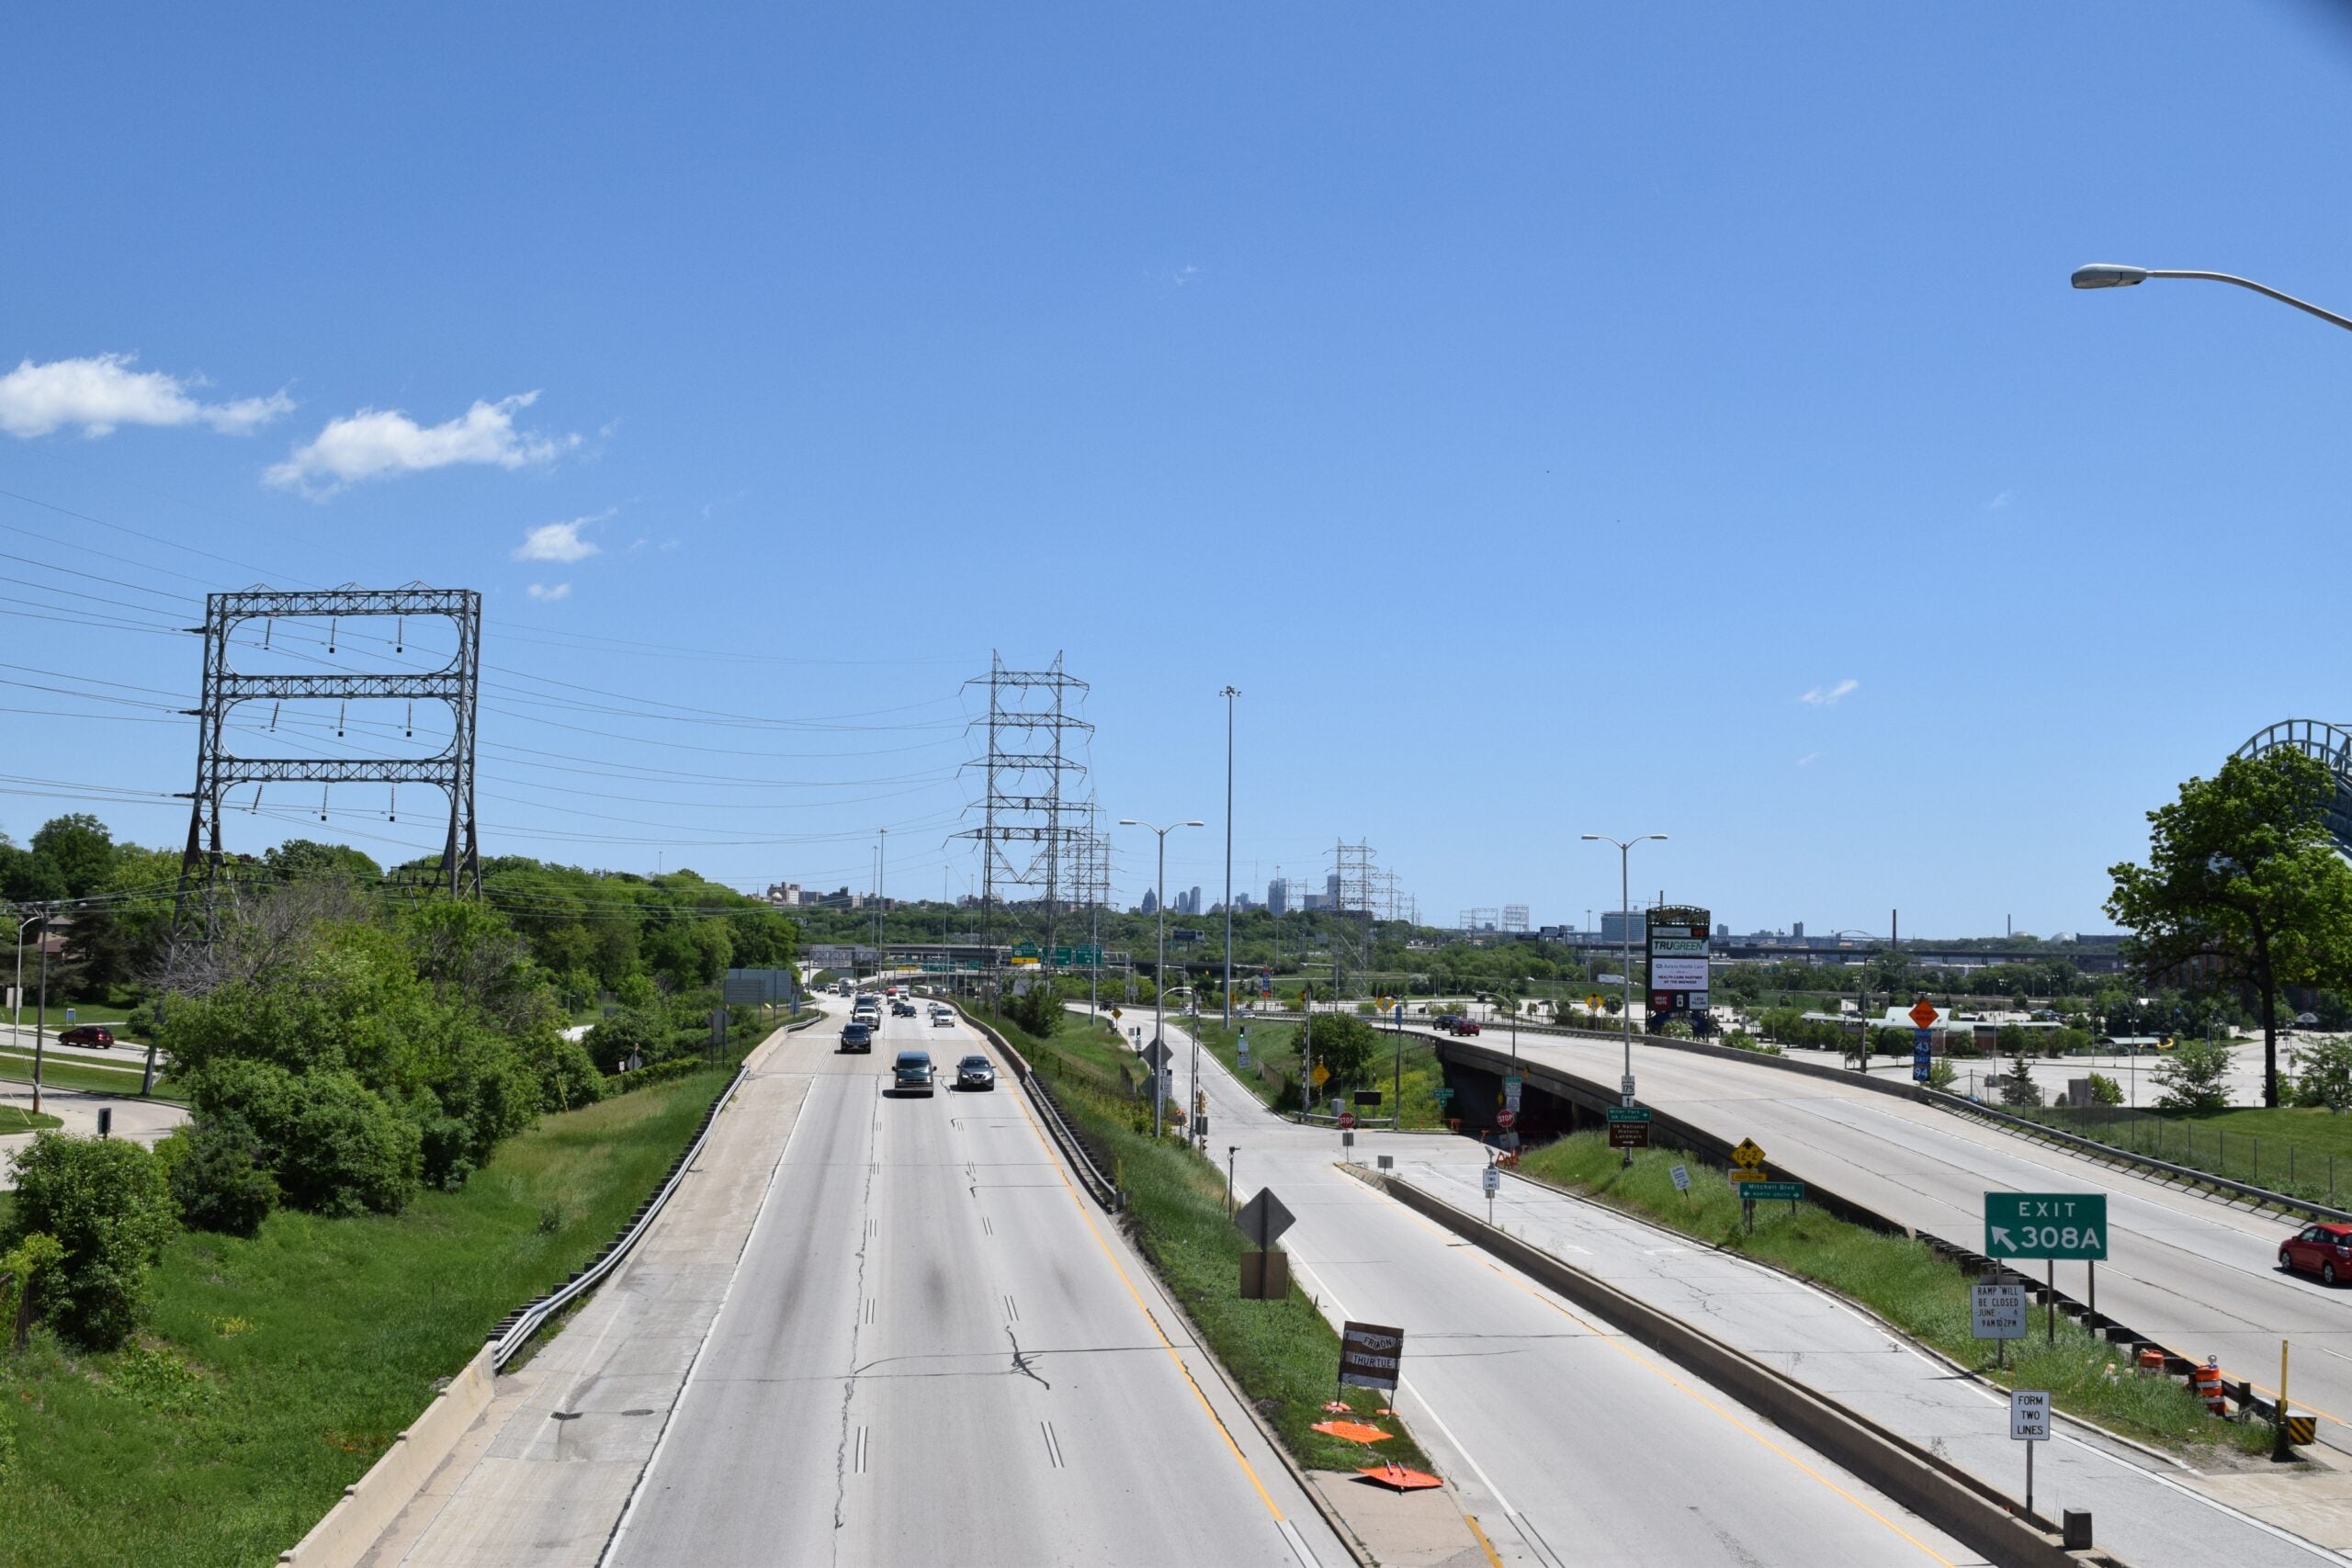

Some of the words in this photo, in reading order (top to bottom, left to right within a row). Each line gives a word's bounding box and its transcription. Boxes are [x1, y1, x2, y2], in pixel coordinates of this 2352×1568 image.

[1654, 941, 1703, 951] TRUGREEN
[1917, 1043, 1928, 1052] 43
[1915, 1067, 1928, 1077] 94
[2018, 1201, 2075, 1217] EXIT
[2020, 1225, 2101, 1249] 308A
[1977, 1286, 1996, 1295] RAMP
[2001, 1287, 2018, 1295] WILL
[1978, 1298, 1987, 1306] BE
[1991, 1298, 2018, 1307] CLOSED
[1353, 1355, 1374, 1367] THUR
[1377, 1359, 1393, 1368] TUE
[2018, 1395, 2043, 1405] FORM
[2021, 1410, 2041, 1420] TWO
[2017, 1425, 2043, 1436] LINES
